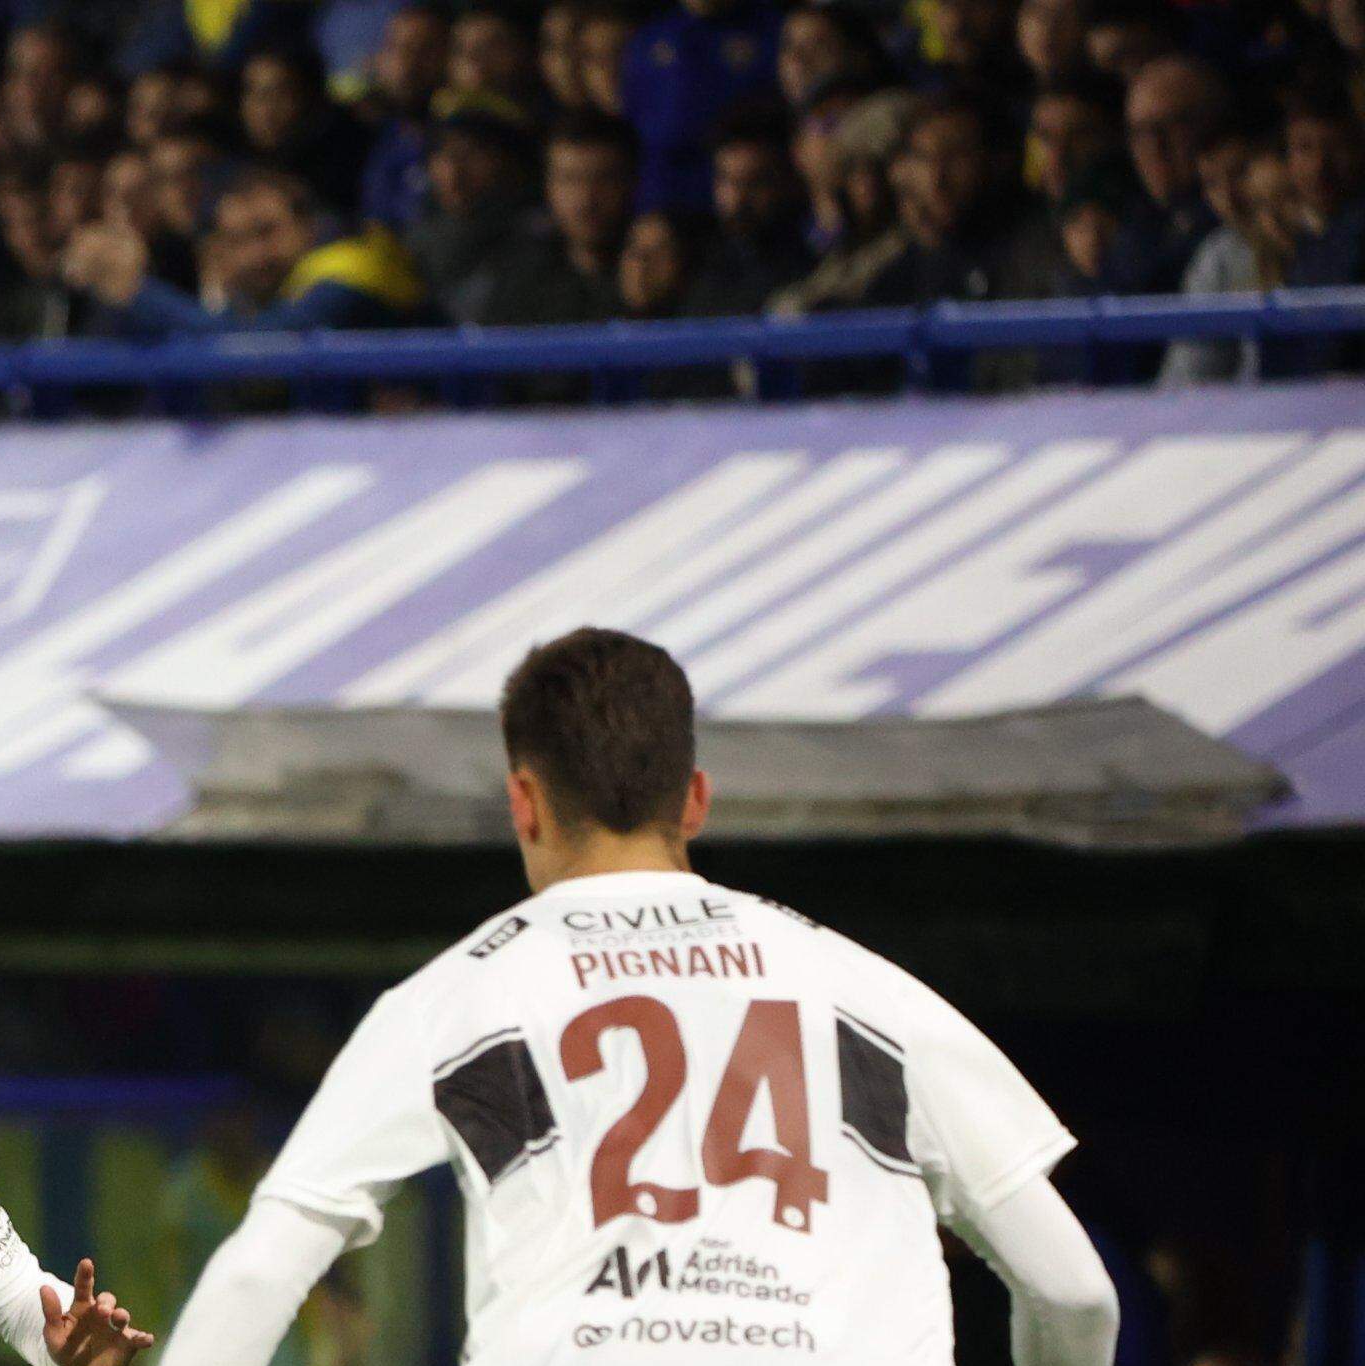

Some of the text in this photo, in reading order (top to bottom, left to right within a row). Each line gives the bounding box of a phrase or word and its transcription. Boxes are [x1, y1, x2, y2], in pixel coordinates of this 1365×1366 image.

[562, 898, 737, 931] CIVILE
[571, 942, 765, 989] PIGNANI
[558, 994, 829, 1234] 24
[686, 1250, 780, 1281] Adrián
[677, 1273, 810, 1307] Mercado
[621, 1316, 818, 1354] novatech
